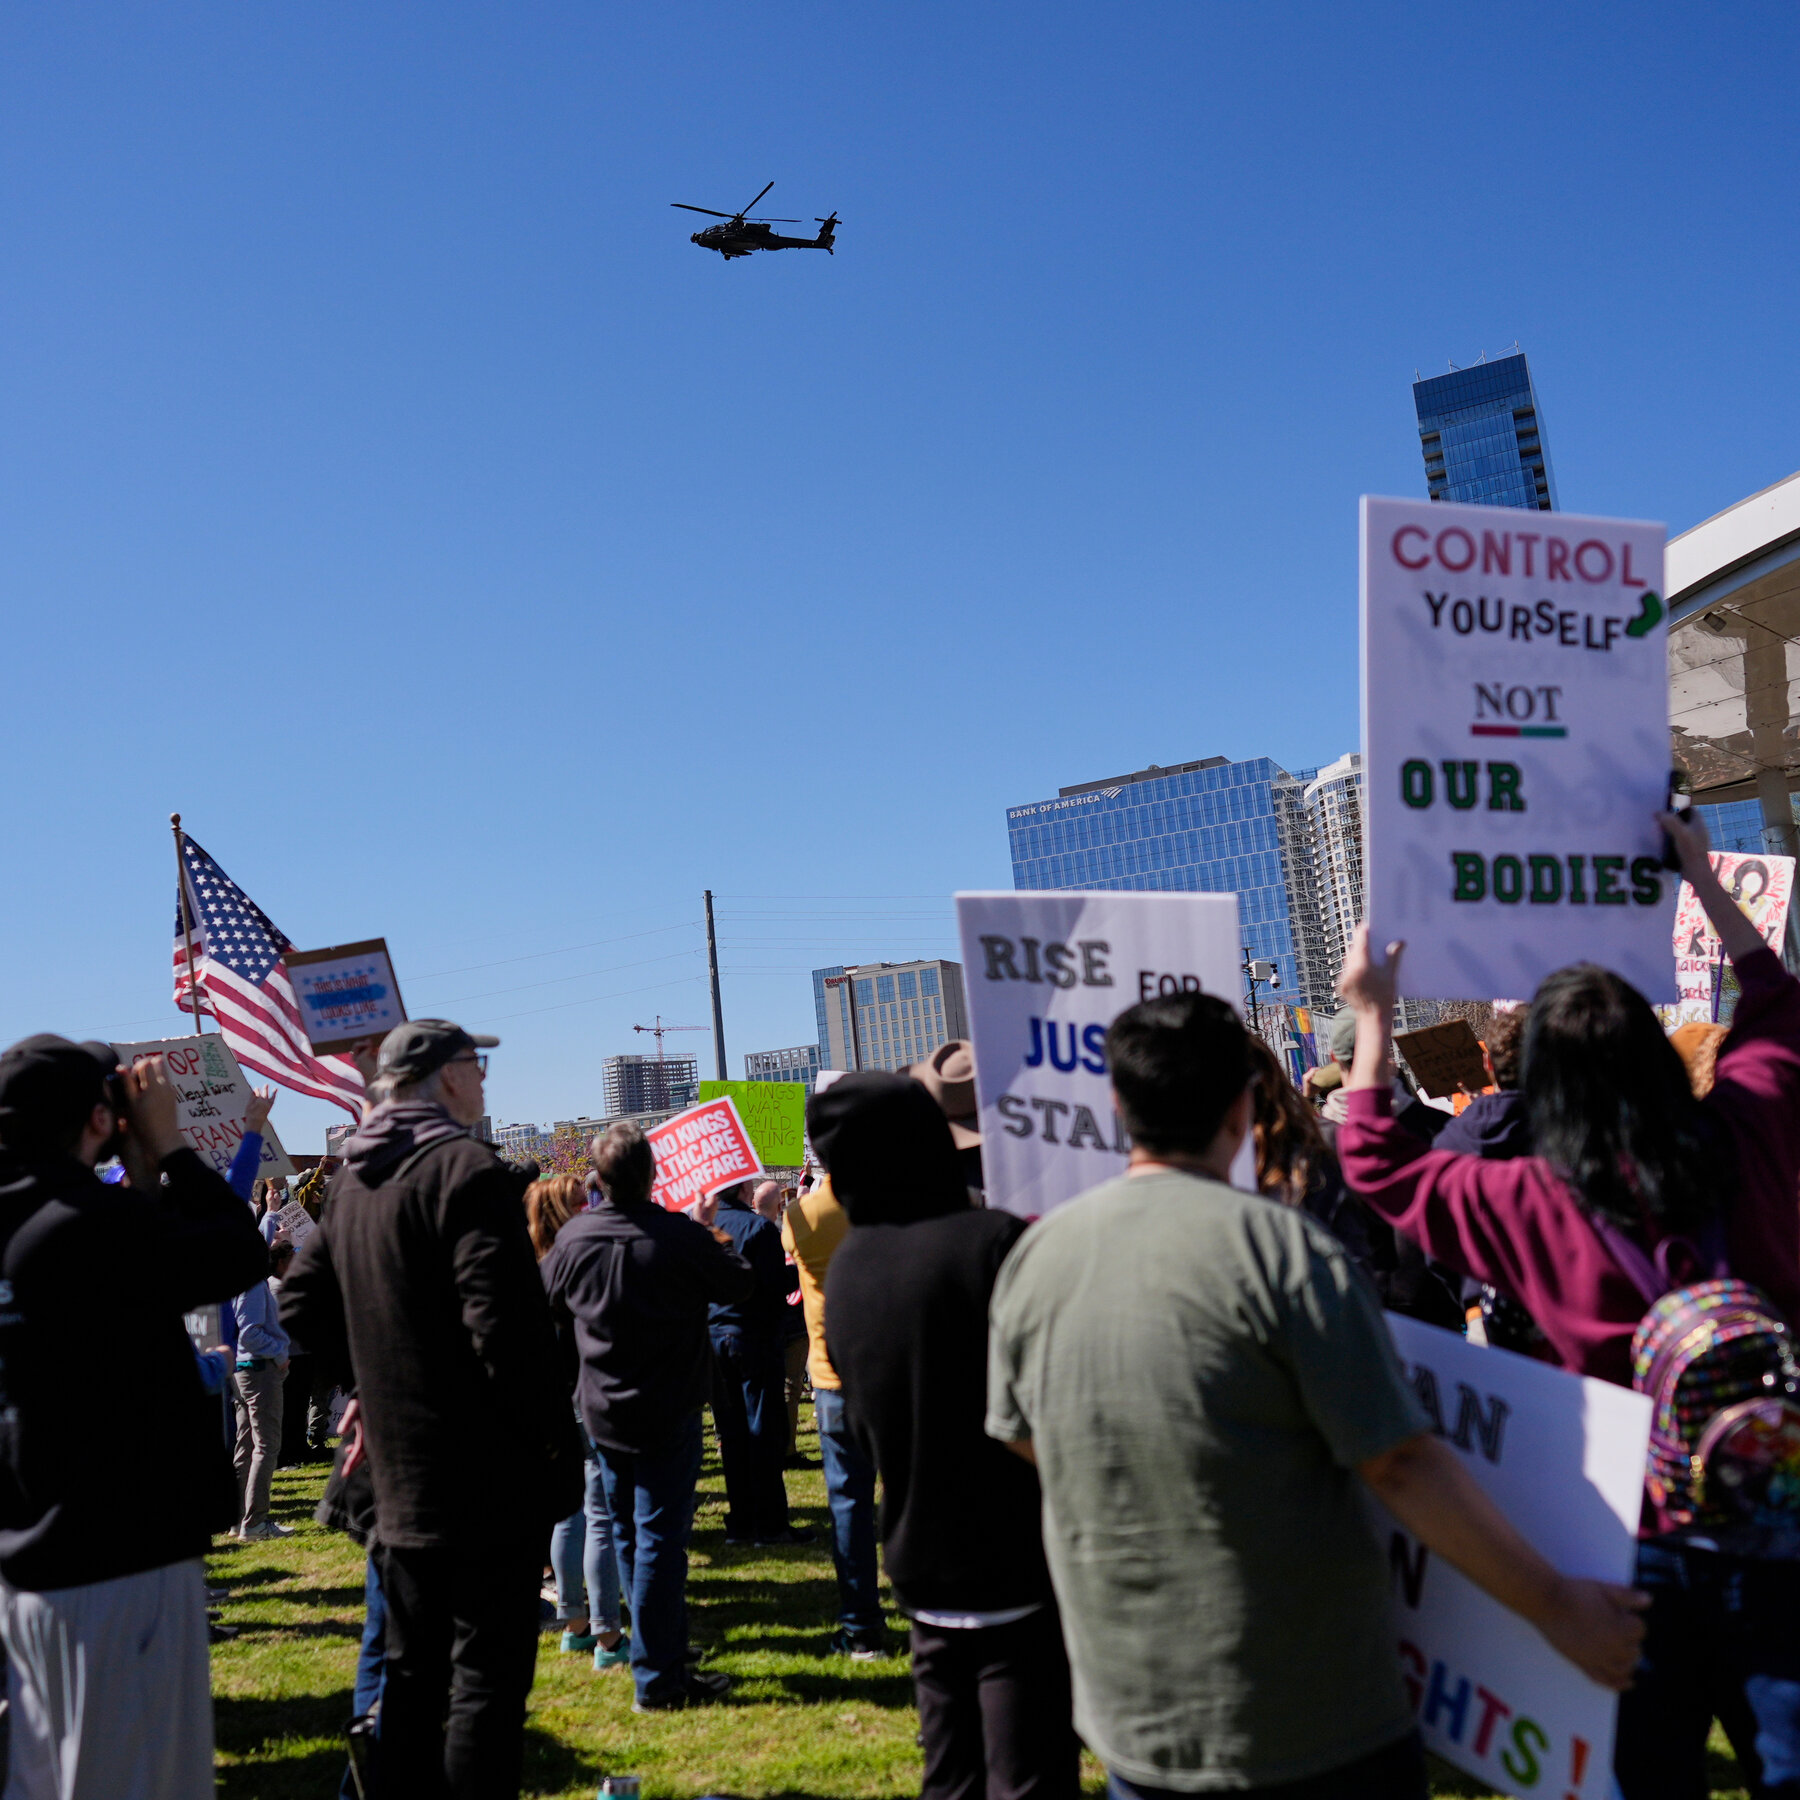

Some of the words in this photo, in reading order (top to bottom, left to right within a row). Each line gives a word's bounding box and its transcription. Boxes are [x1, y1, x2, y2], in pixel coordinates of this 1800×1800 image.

[1391, 525, 1647, 588] CONTROL
[1423, 591, 1622, 651] YOURSELF
[1473, 682, 1562, 722] NOT
[1009, 807, 1037, 819] BANK
[1039, 803, 1052, 813] OF
[1054, 794, 1101, 810] AMERICA
[1401, 759, 1527, 812] OUR
[1452, 852, 1665, 906] BODIES
[979, 934, 1114, 989] RISE
[712, 1083, 738, 1098] NO
[747, 1083, 796, 1100] KINGS
[747, 1100, 781, 1115] WAR
[650, 1132, 679, 1161] NO
[675, 1109, 730, 1147] KINGS
[744, 1114, 792, 1131] CHILD
[665, 1149, 749, 1203] WARFARE
